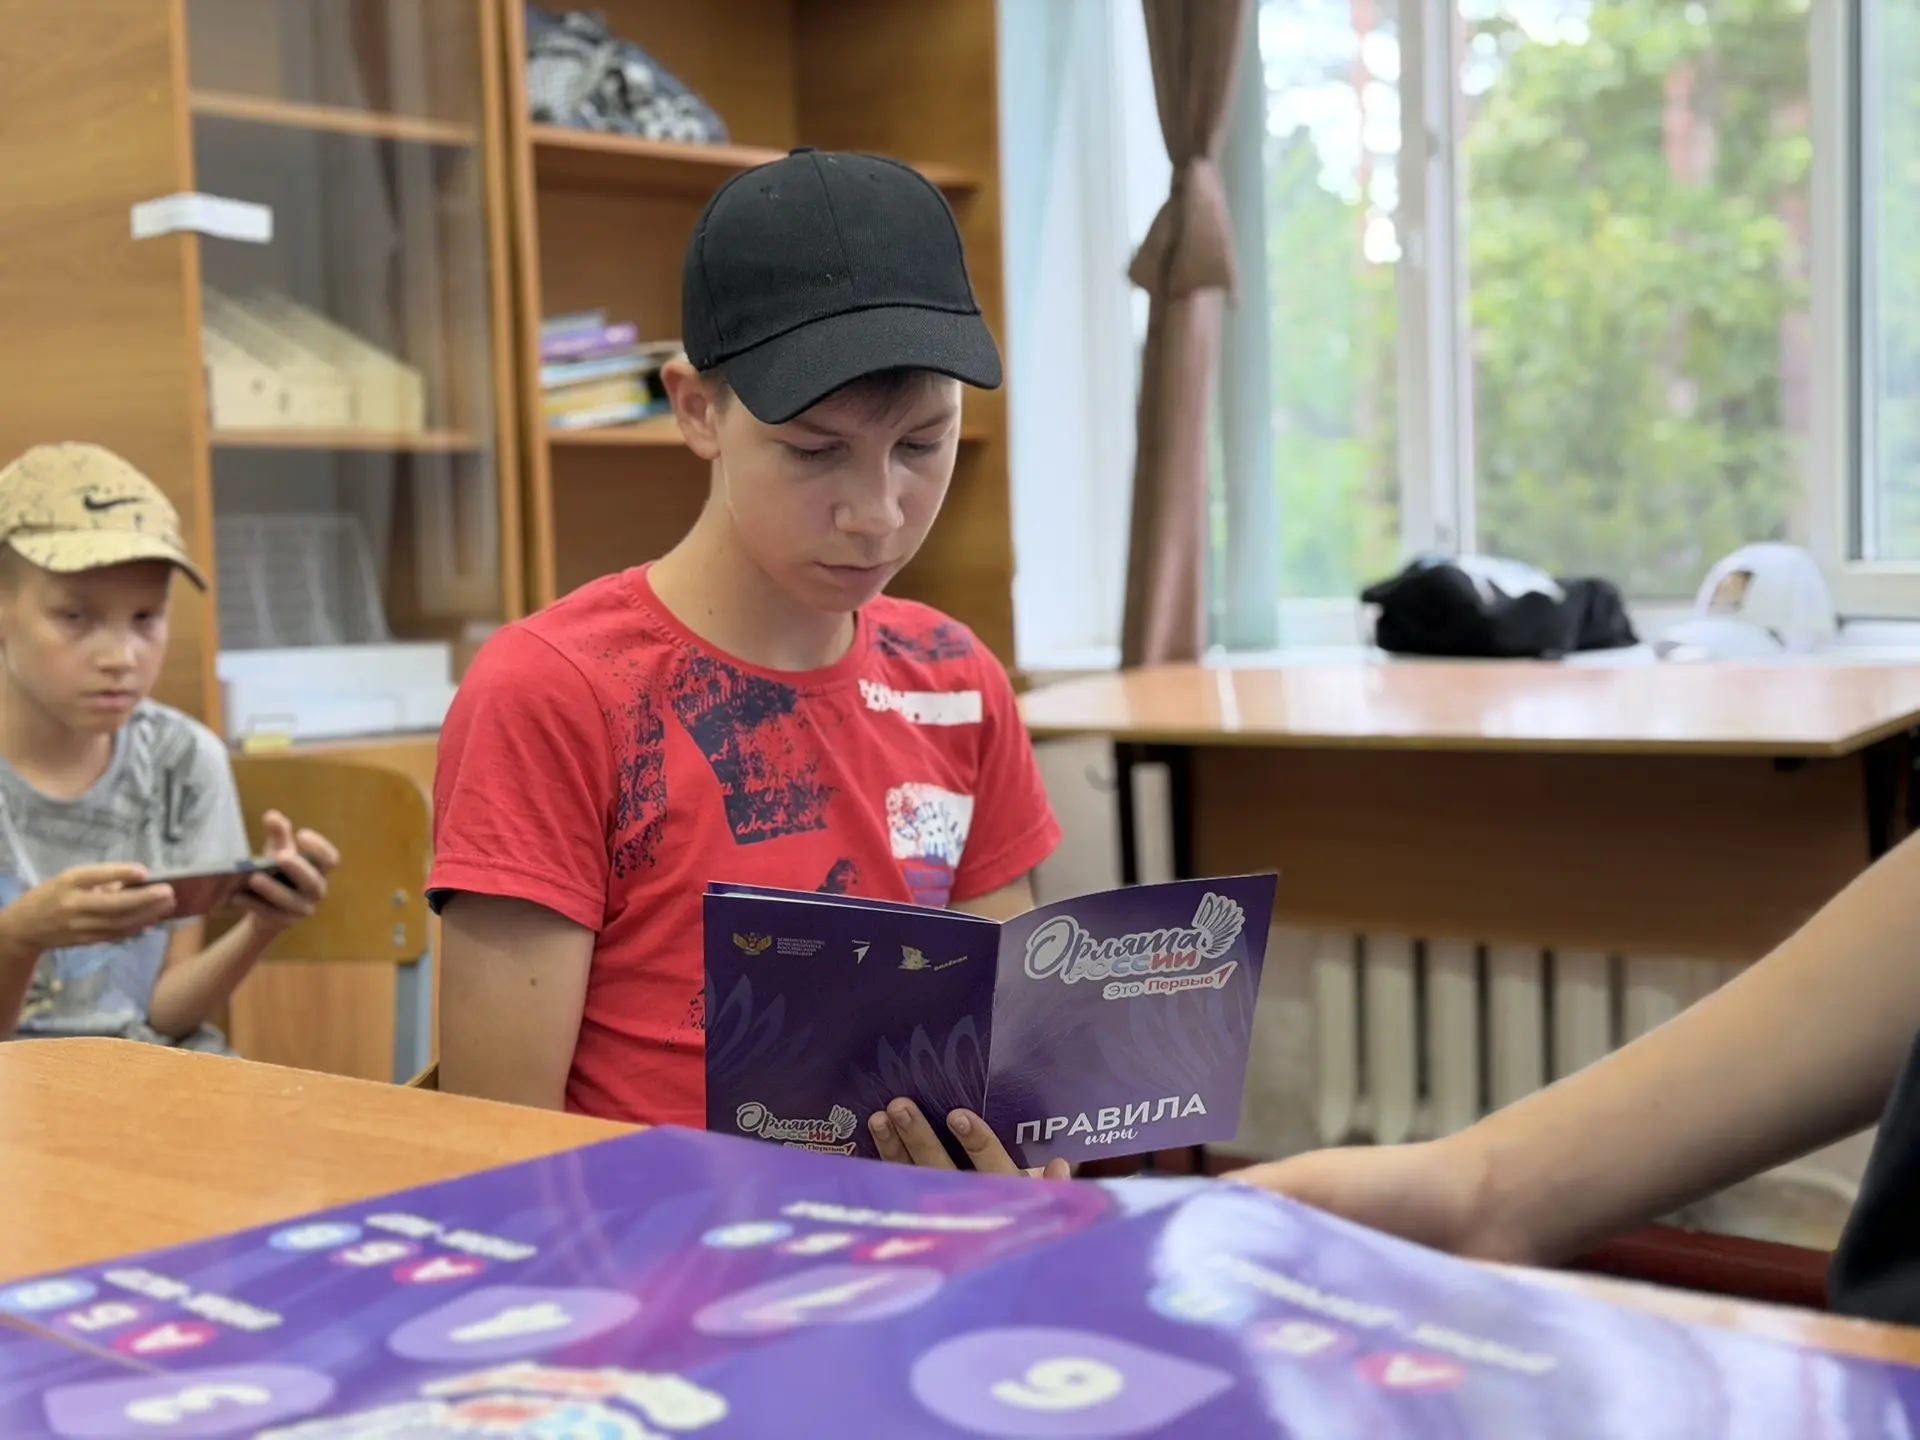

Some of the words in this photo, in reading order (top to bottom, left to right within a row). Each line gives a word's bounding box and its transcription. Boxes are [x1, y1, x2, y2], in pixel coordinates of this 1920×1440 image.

[1029, 918, 1202, 977] Орлята
[1108, 984, 1140, 997] Это
[1148, 976, 1214, 992] Первые
[739, 1103, 835, 1133] Орлята
[1015, 1093, 1207, 1145] ПРАВИЛА
[1085, 1127, 1139, 1146] игры
